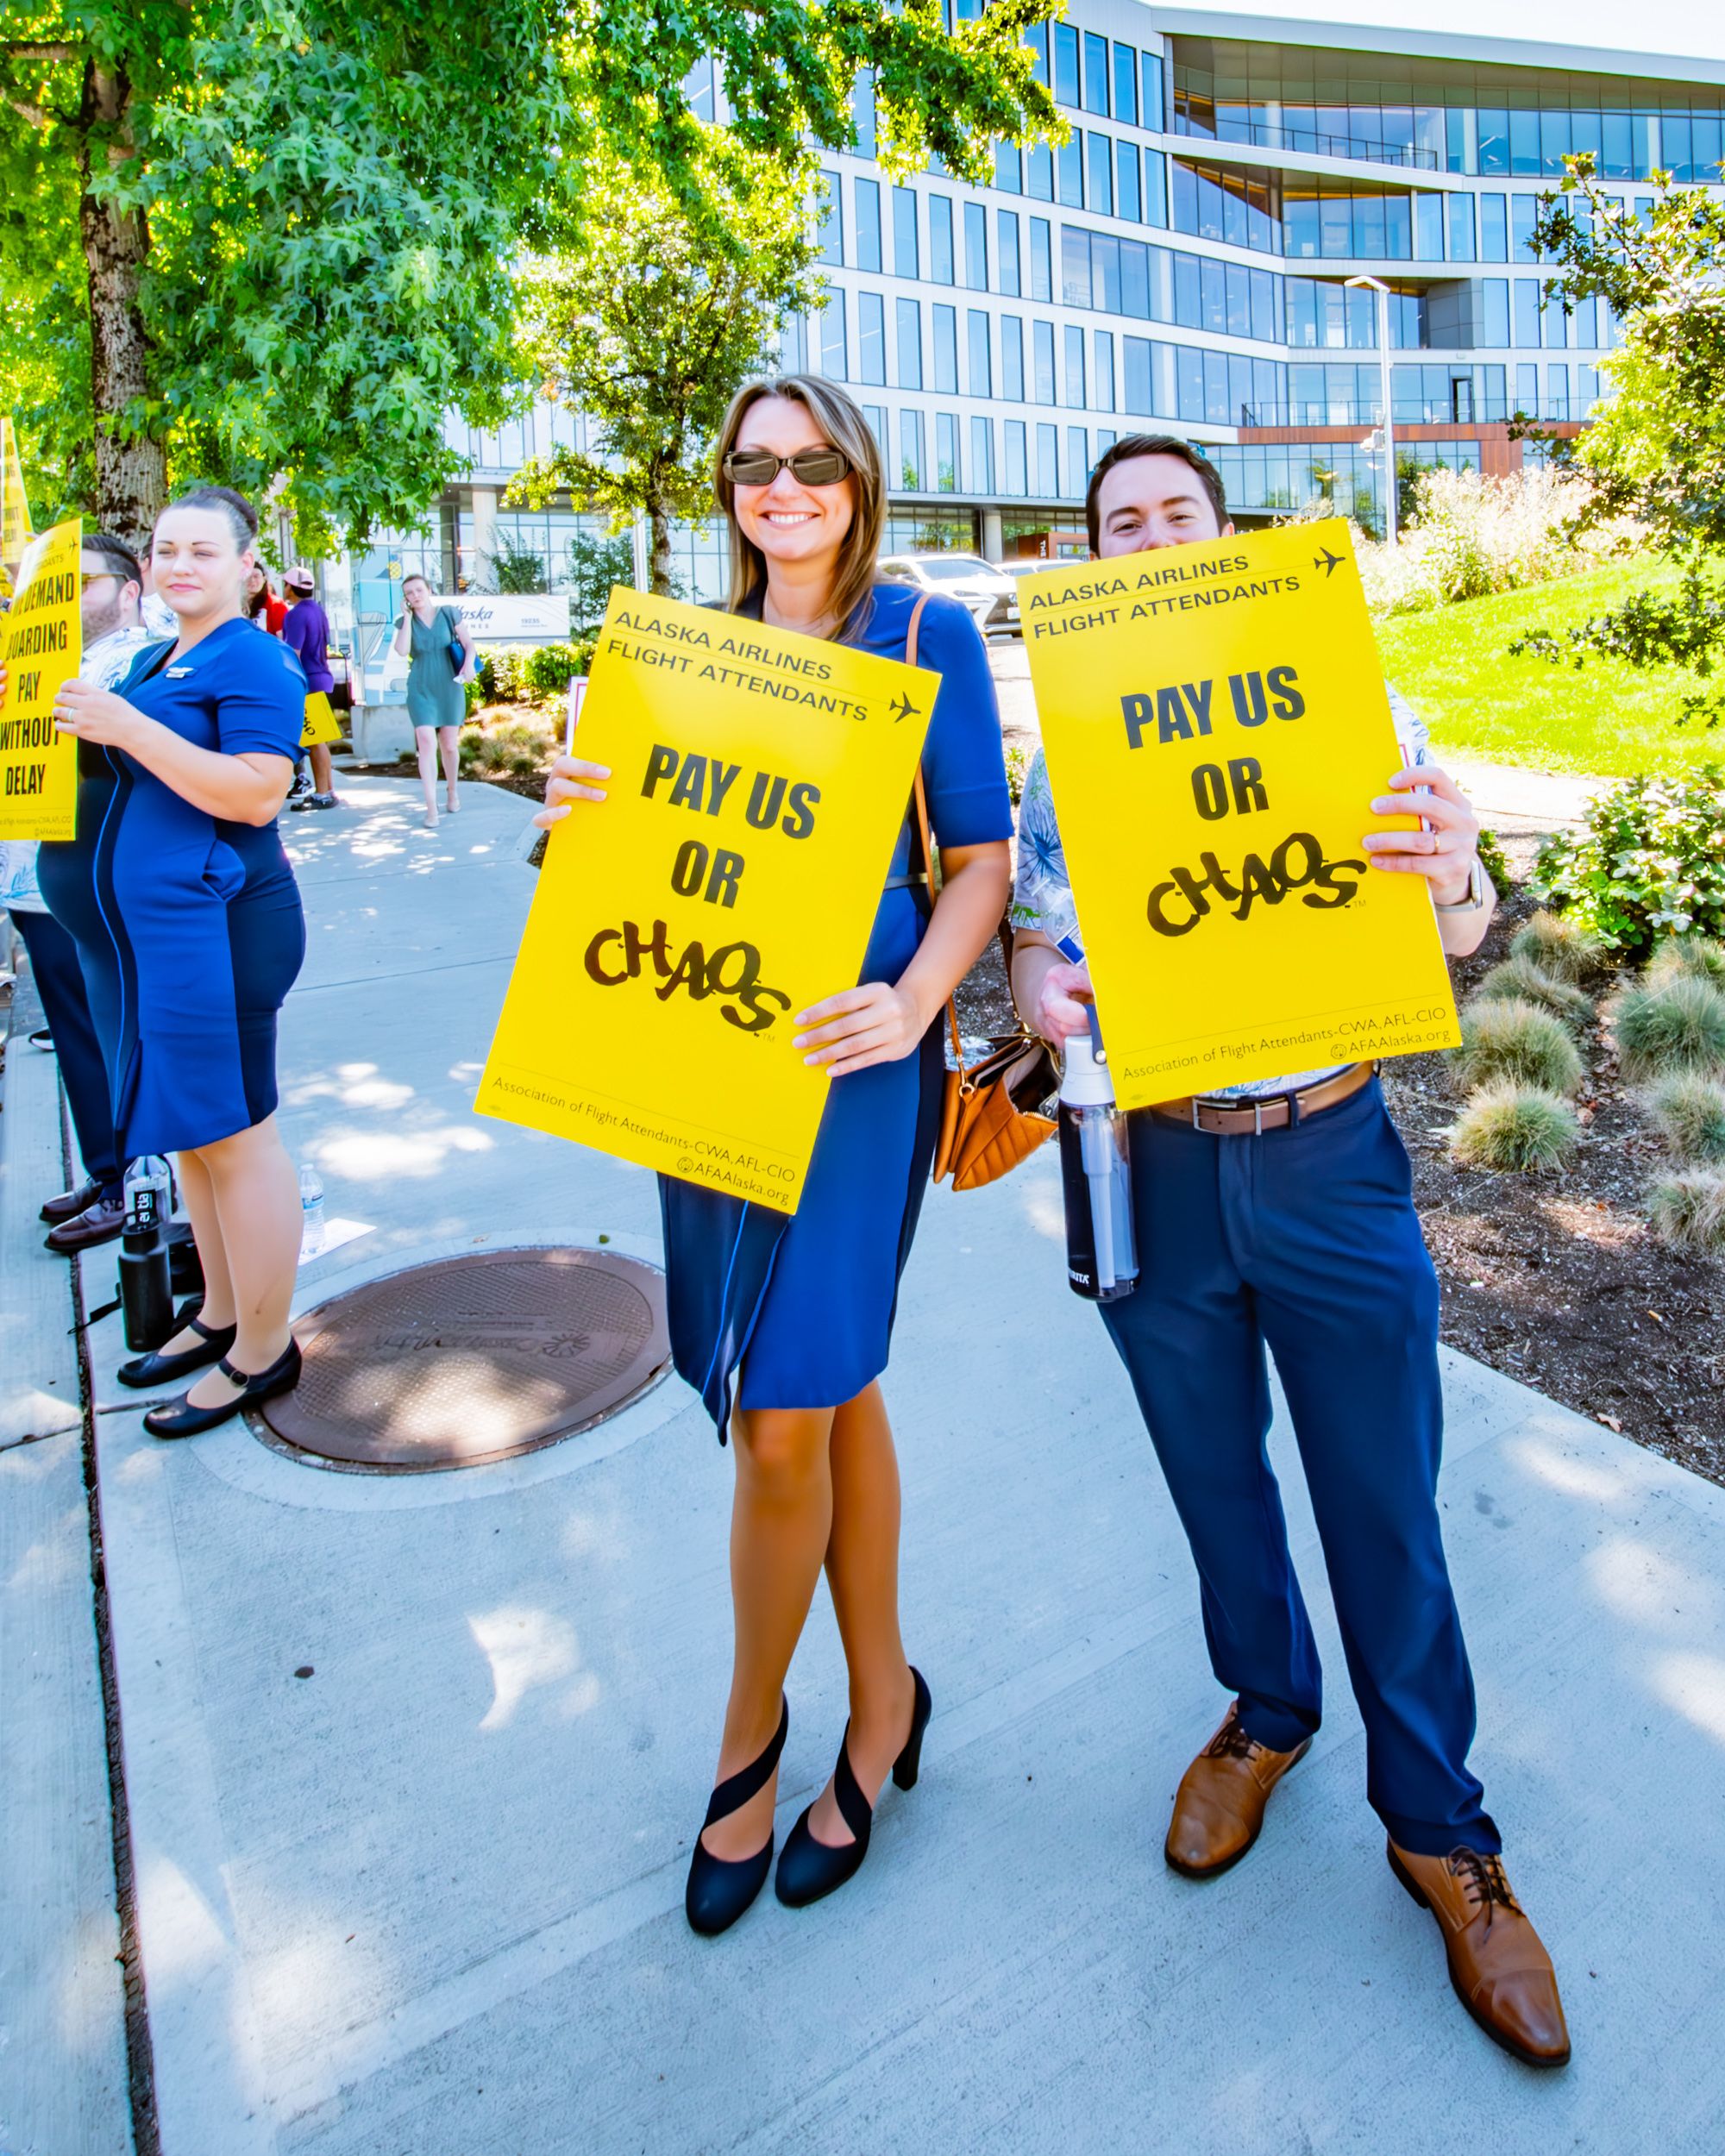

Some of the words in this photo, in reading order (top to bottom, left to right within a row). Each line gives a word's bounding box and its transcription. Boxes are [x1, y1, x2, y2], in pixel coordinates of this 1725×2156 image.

[1030, 580, 1129, 610] ALASKA
[1137, 555, 1249, 590] AIRLINES
[1033, 609, 1120, 639] FLIGHT
[1130, 576, 1301, 620] ATTENDANTS
[6, 620, 67, 661] BOARDING
[615, 612, 710, 648] ALASKA
[718, 639, 831, 680] AIRLINES
[17, 671, 41, 702] PAY
[607, 640, 693, 673] FLIGHT
[699, 665, 868, 721] ATTENDANTS
[1120, 679, 1213, 750] PAY
[1228, 666, 1306, 728] US
[5, 764, 46, 795] DELAY
[640, 743, 742, 817] PAY
[745, 771, 821, 840] US
[1191, 756, 1270, 821] OR
[670, 840, 745, 909] OR
[1146, 832, 1367, 937] CHAOS
[584, 918, 792, 1032] CHAOS
[1123, 1054, 1199, 1081] Association
[1204, 1048, 1217, 1062] of
[1220, 1042, 1258, 1062] Flight
[492, 1076, 566, 1109] Association
[569, 1101, 584, 1114] of
[586, 1104, 618, 1126] Flight
